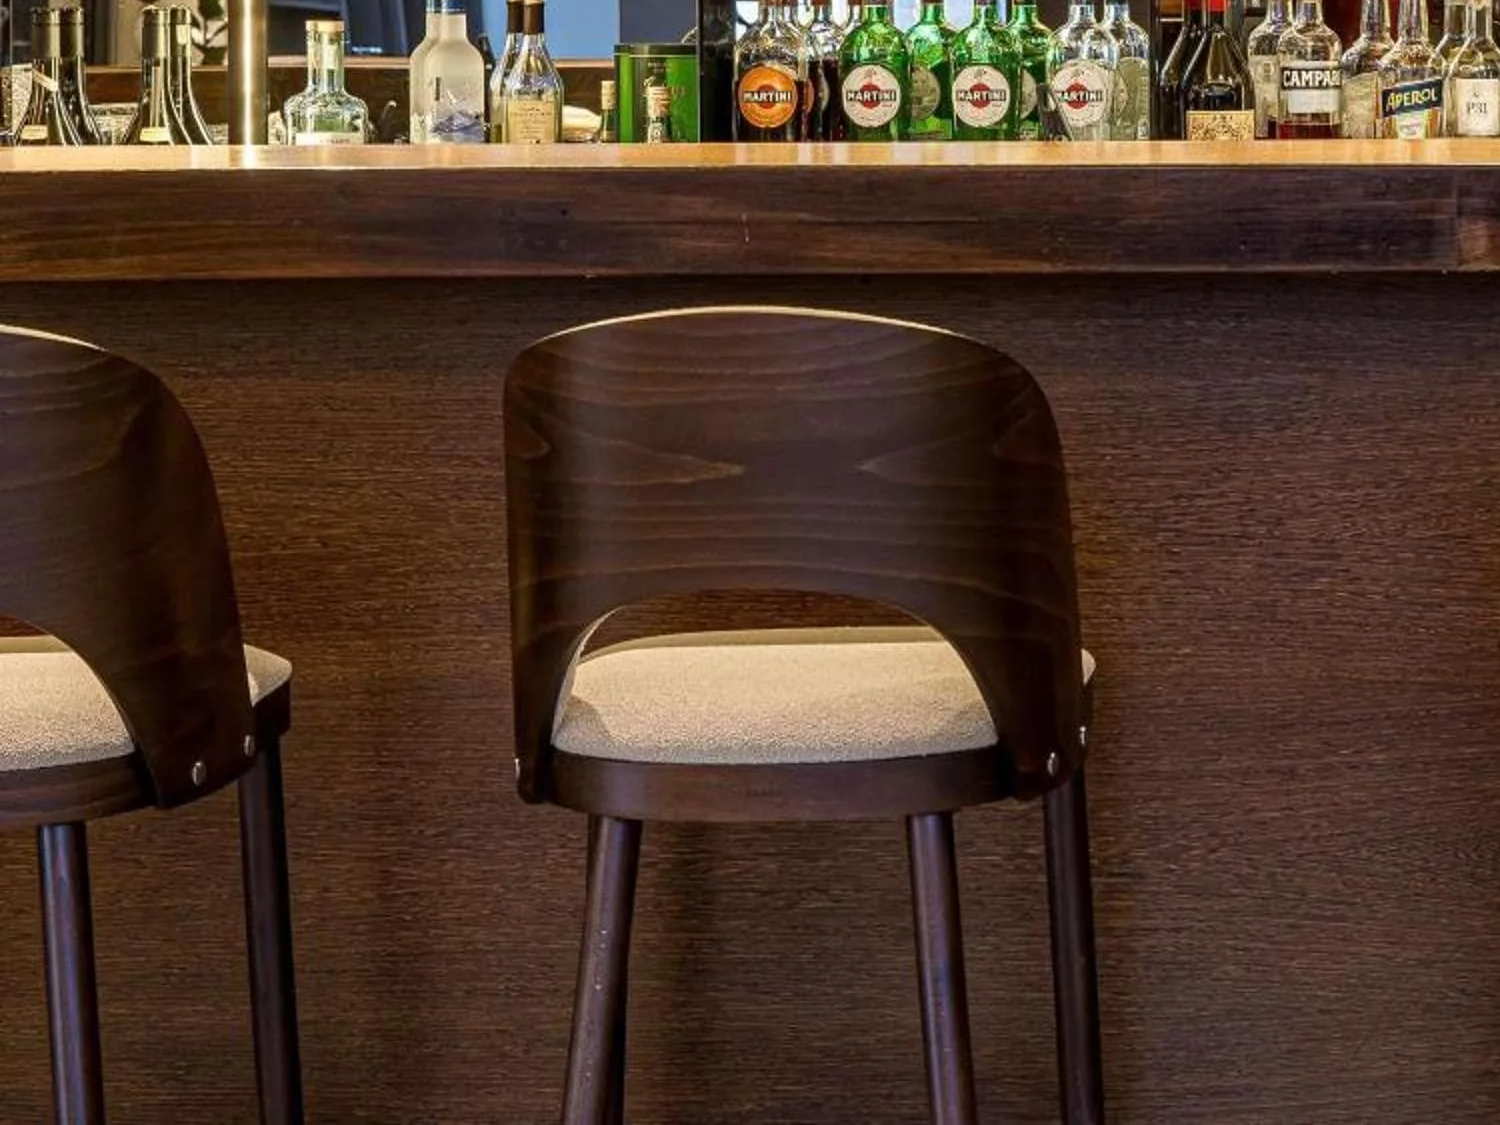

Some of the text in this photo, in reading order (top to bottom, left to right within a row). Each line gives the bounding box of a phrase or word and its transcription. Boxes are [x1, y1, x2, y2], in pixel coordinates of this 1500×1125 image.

[744, 91, 791, 102] MARTINI
[848, 91, 895, 102] MARTINI
[957, 90, 1004, 102] MARTINI
[1387, 88, 1438, 110] APEROL
